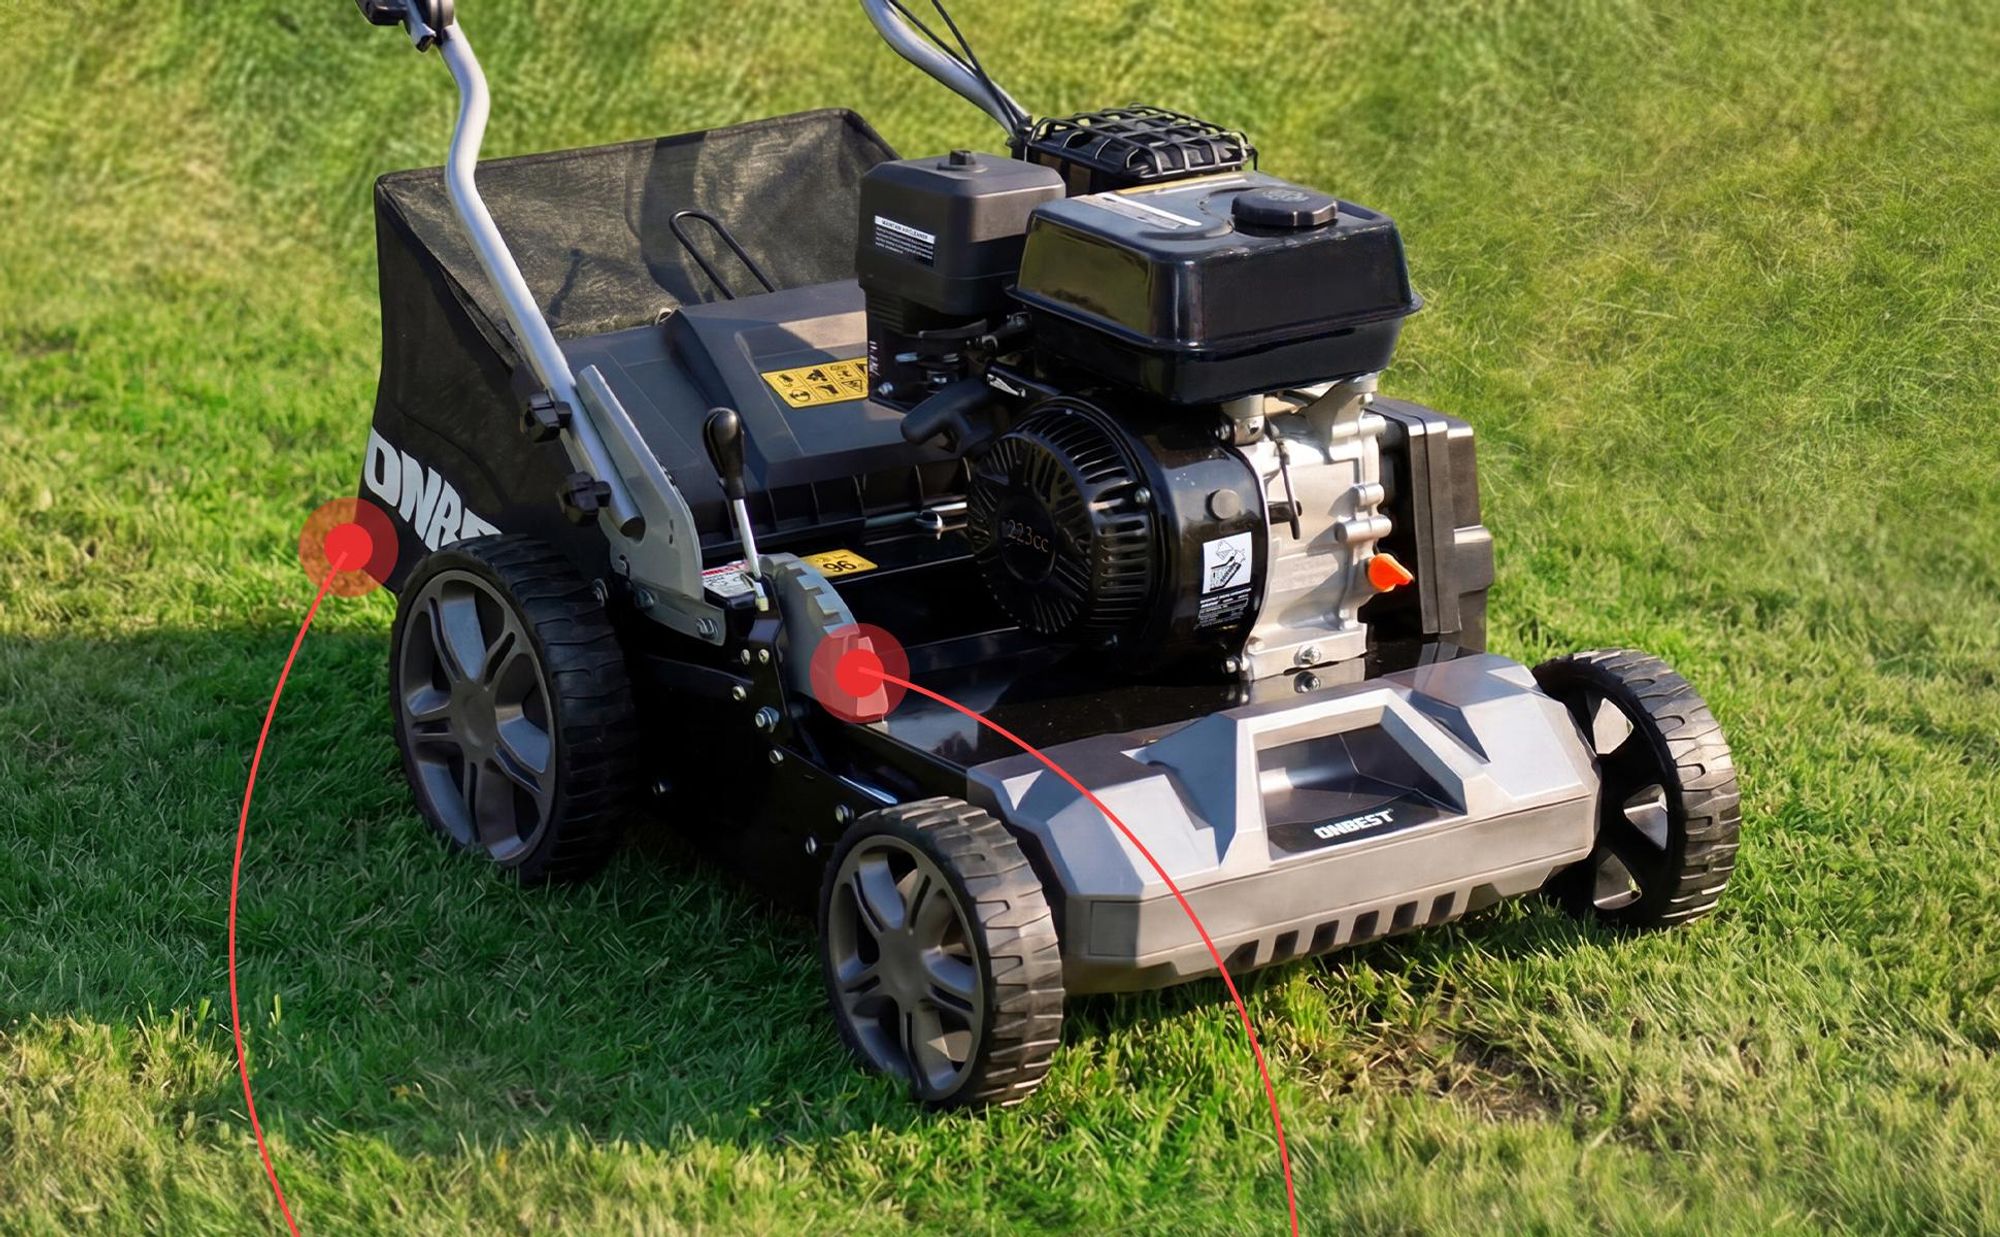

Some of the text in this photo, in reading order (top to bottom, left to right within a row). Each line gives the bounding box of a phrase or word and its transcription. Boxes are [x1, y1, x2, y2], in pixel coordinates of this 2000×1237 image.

[1008, 519, 1049, 552] 223cc
[823, 560, 857, 573] 96
[1313, 810, 1394, 839] ONBEST
